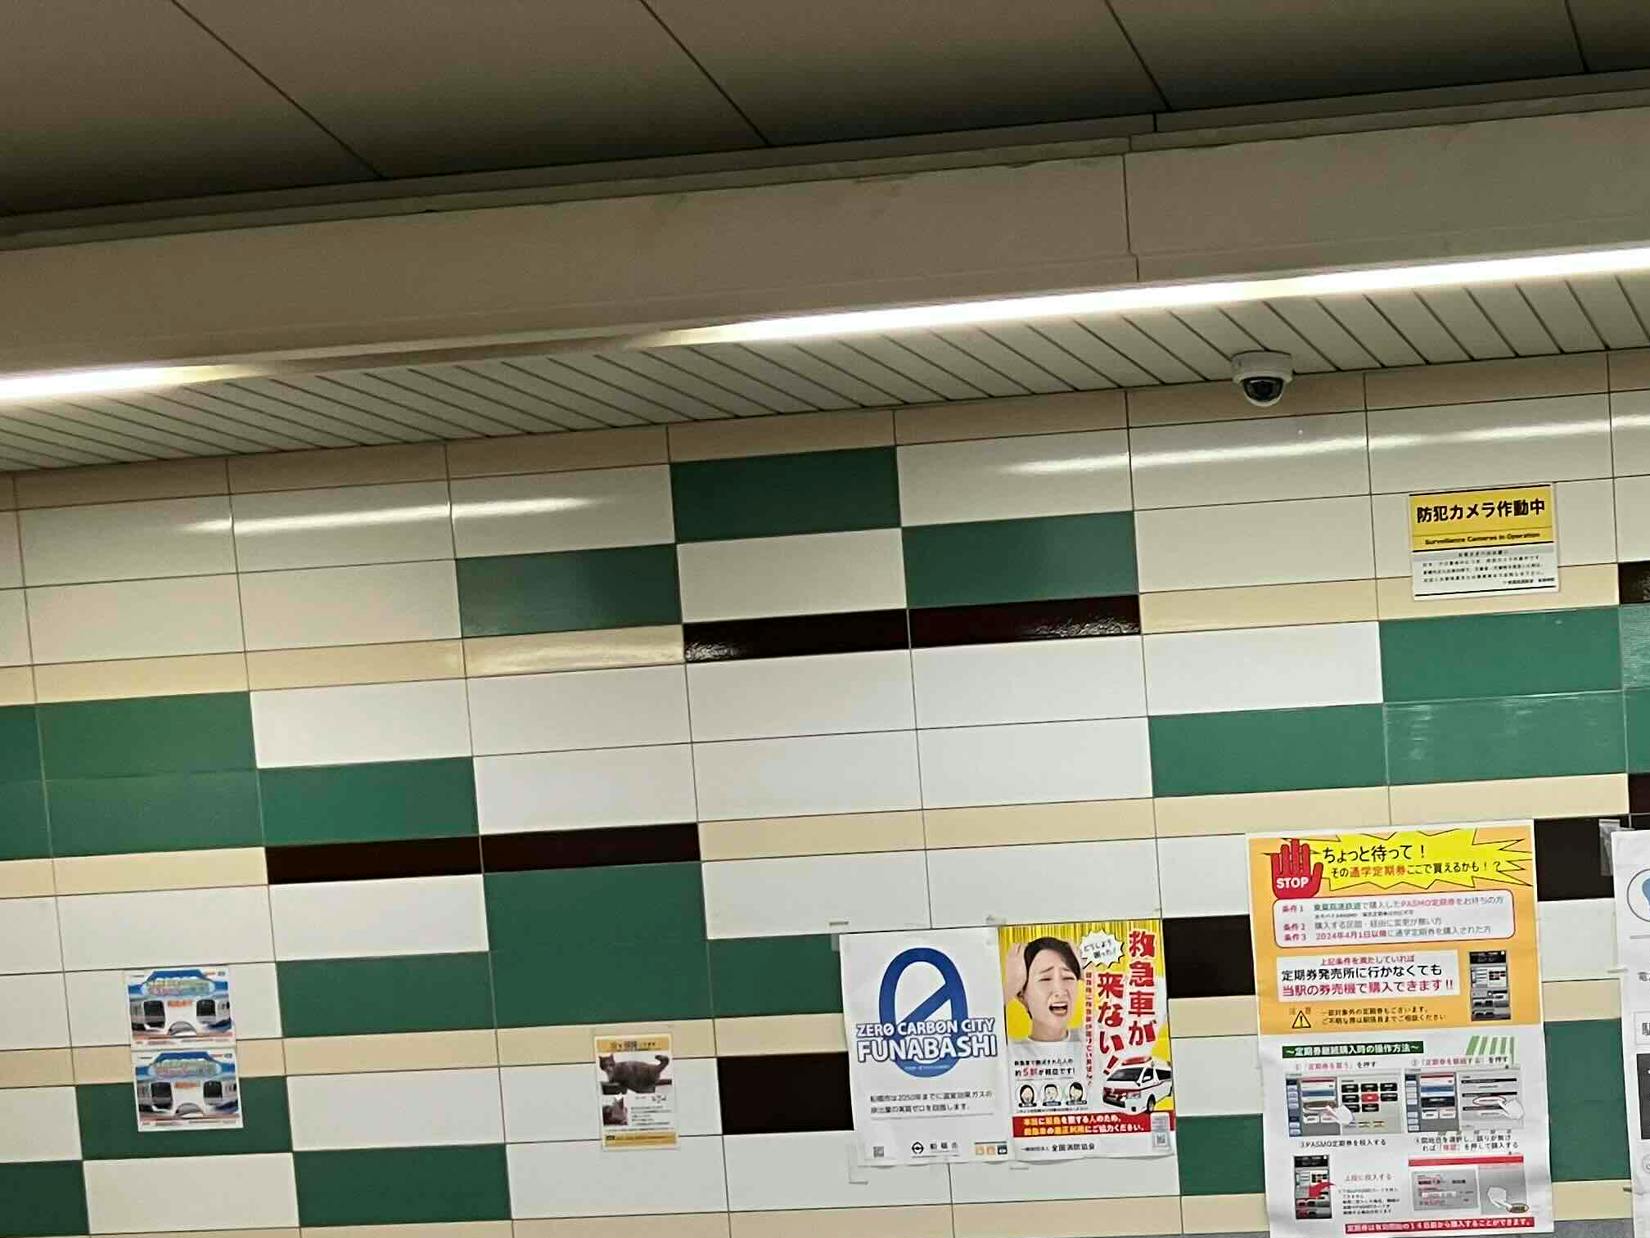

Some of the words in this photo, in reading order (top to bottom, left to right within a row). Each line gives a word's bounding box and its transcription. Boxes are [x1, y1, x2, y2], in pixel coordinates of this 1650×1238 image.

[1417, 498, 1545, 523] 防犯カメラ作動中
[1322, 844, 1426, 863] ちょっと待って！
[1275, 876, 1310, 890] STOP
[1281, 964, 1442, 982] 定期券発売所に行かなくても
[1128, 930, 1157, 1047] 救急車が
[963, 1017, 995, 1034] CITY
[857, 1033, 998, 1064] FUNABASHI
